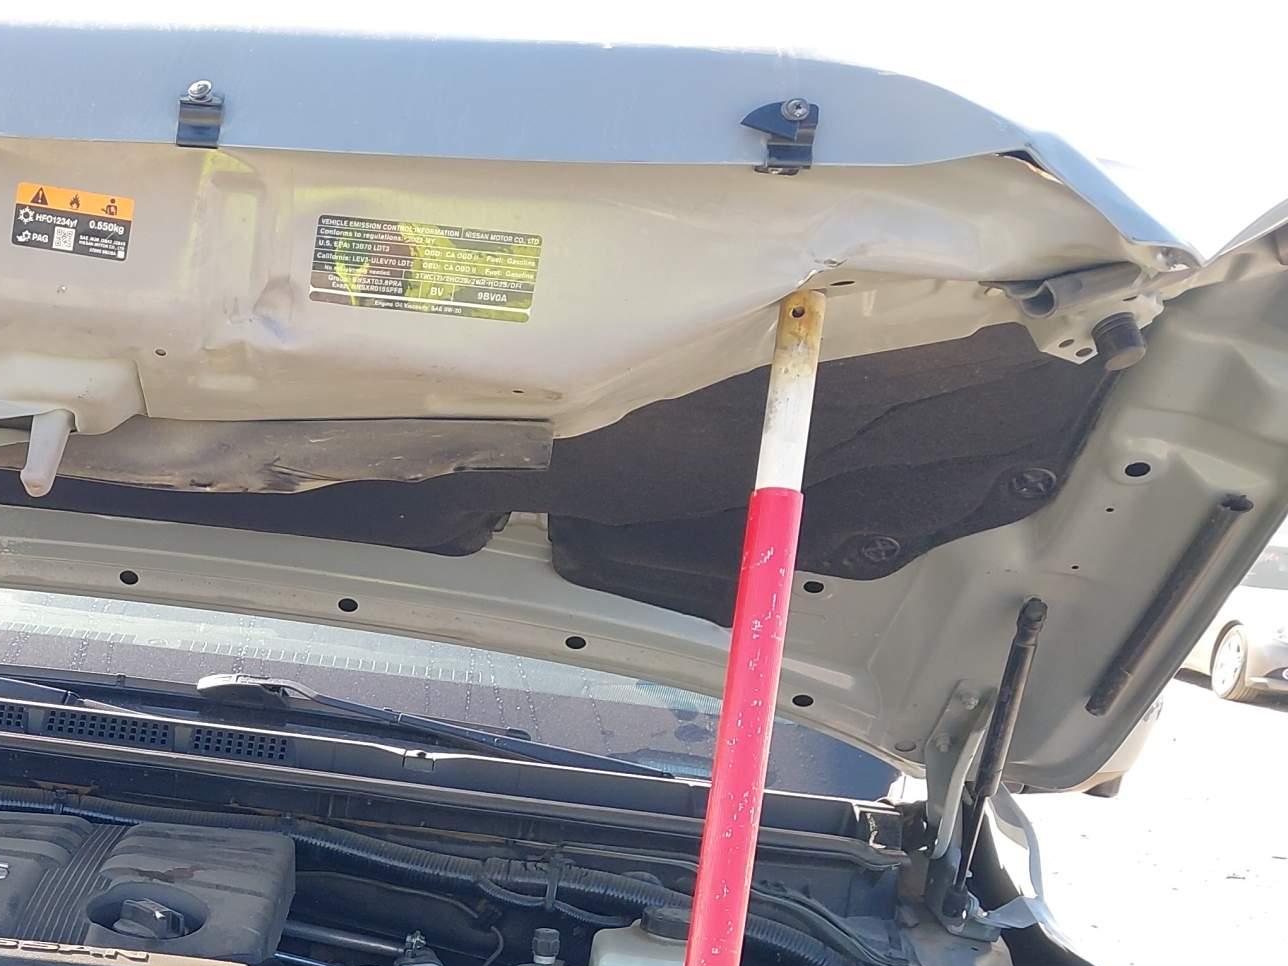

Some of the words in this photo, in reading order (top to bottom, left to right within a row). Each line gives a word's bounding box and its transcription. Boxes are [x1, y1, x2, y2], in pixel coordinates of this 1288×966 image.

[35, 213, 79, 228] HFO1234yf
[320, 228, 353, 238] Conforms
[354, 230, 361, 238] to
[322, 218, 348, 227] VEHICLE
[349, 220, 382, 230] EMISSION
[383, 223, 412, 234] CONTROL
[412, 225, 460, 237] INFORMATION
[32, 232, 49, 243] PAG
[466, 231, 489, 242] NISSAN
[490, 233, 512, 243] MOTOR
[319, 239, 333, 248] U.S.
[317, 252, 351, 263] California:
[446, 250, 456, 259] CA
[443, 263, 454, 272] CA
[505, 269, 534, 280] Gasoline
[429, 286, 444, 297] BV
